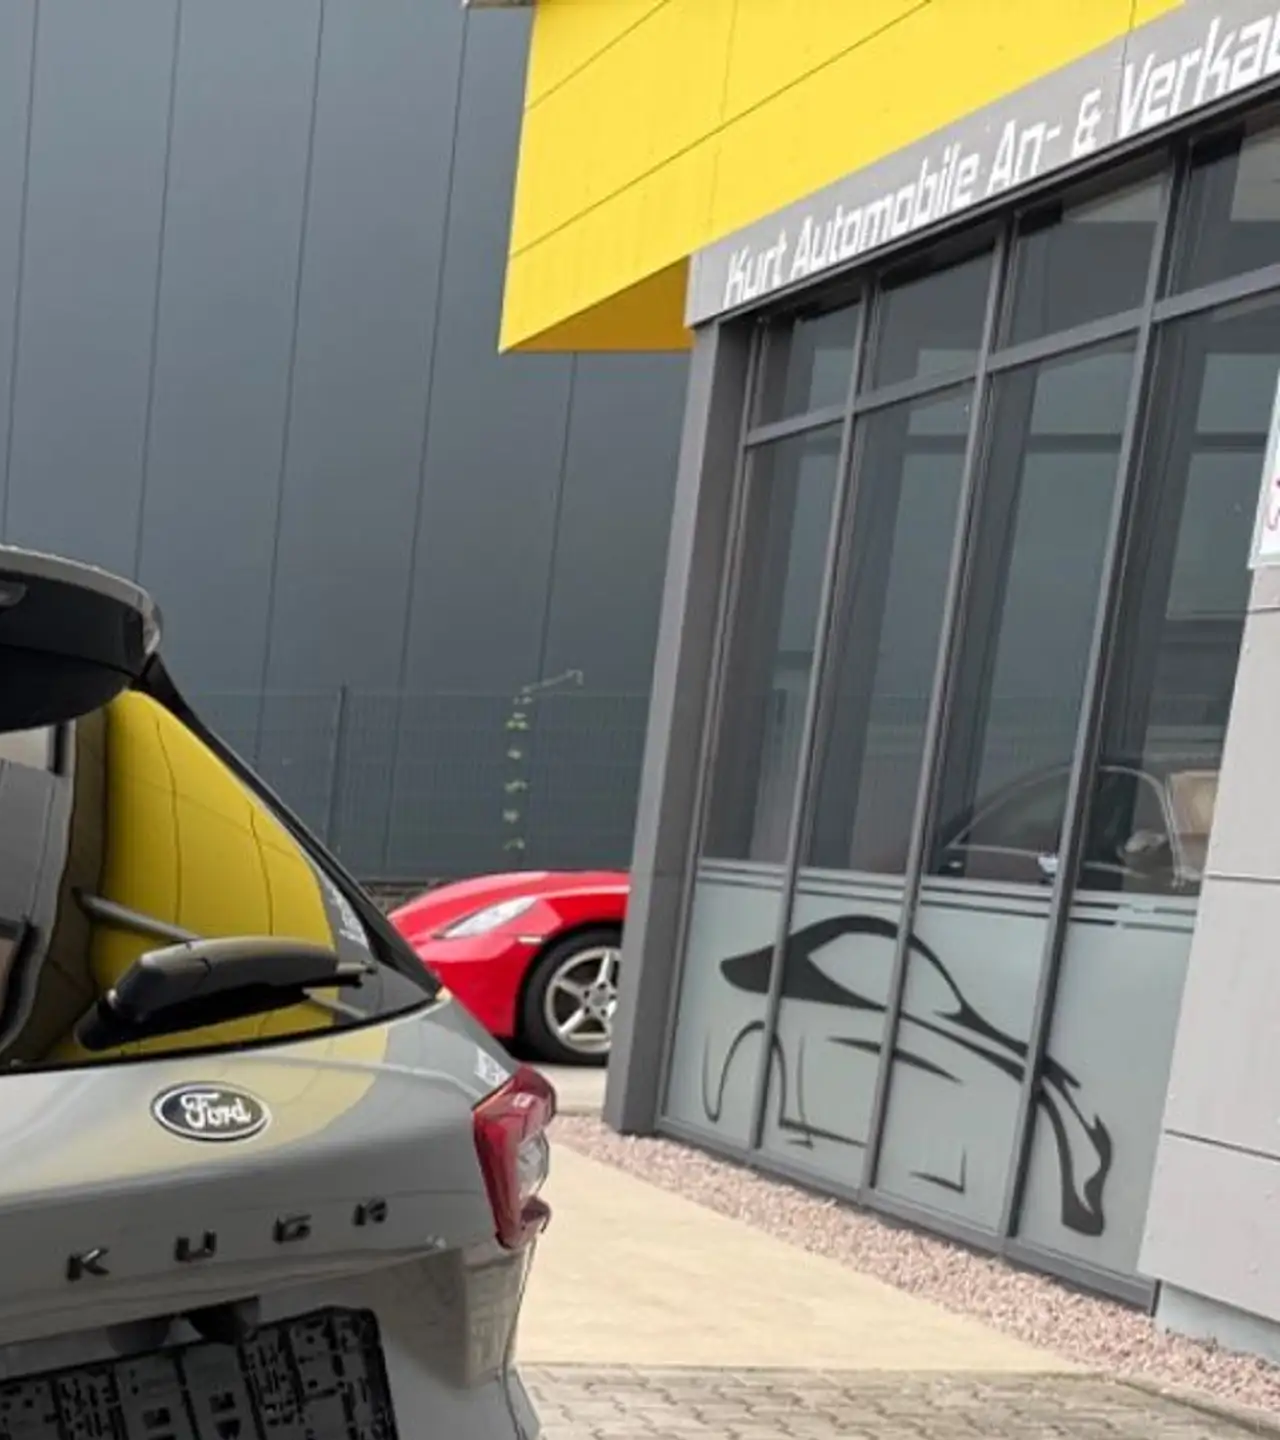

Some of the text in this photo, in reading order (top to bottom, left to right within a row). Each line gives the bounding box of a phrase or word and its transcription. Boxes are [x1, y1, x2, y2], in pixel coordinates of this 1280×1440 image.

[722, 228, 788, 309] Kurt
[790, 141, 980, 279] Automobile
[985, 119, 1063, 196] An-
[1070, 87, 1104, 158] &
[179, 1091, 252, 1130] Ford
